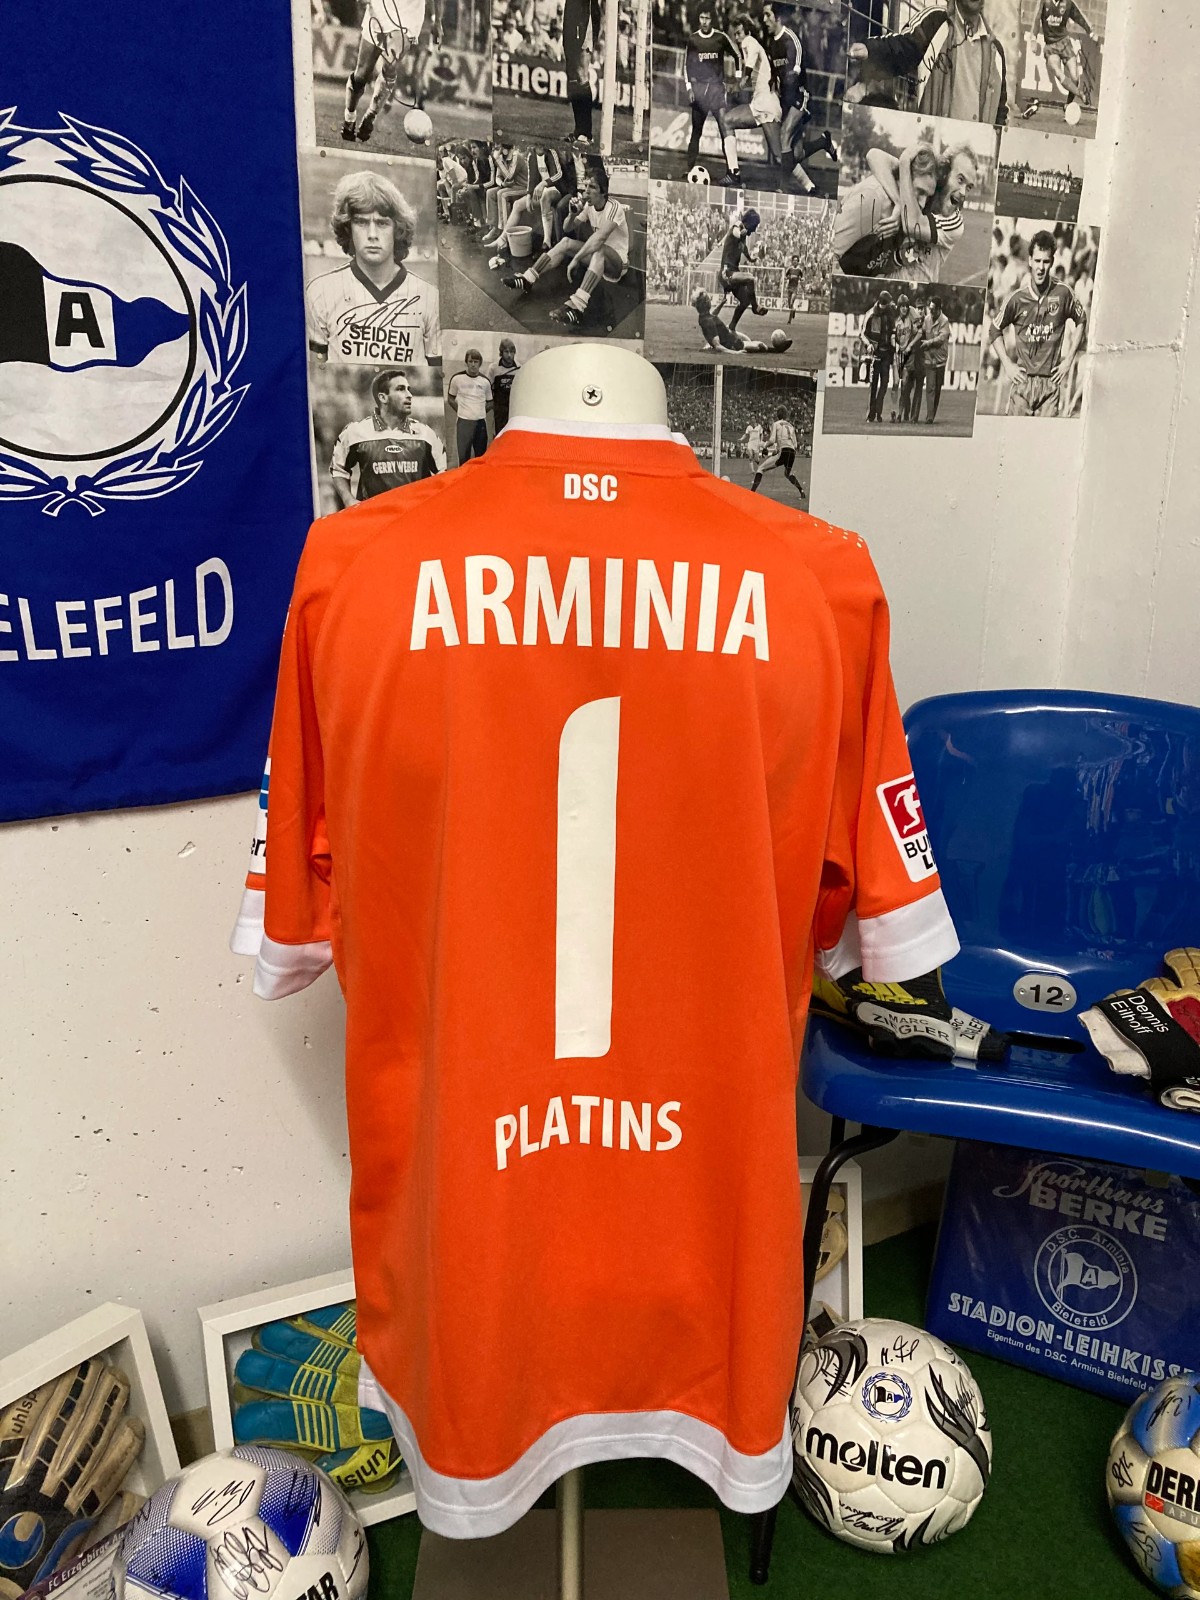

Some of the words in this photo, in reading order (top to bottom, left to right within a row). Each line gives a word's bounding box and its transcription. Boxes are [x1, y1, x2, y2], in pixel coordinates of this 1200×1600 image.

[55, 291, 105, 349] A
[350, 324, 410, 347] SEIDEN
[341, 340, 414, 363] STICKER
[372, 460, 396, 475] GERRY
[396, 460, 418, 474] WEBER
[563, 473, 618, 501] DSC
[409, 554, 770, 662] ARMINIA
[904, 834, 932, 859] BU
[554, 696, 621, 1060] 1
[1029, 984, 1064, 1006] 12
[1128, 995, 1169, 1034] Dennis
[872, 1013, 950, 1042] ZIEGLER
[888, 1013, 929, 1025] MARC
[1110, 1000, 1154, 1035] Eilhoff
[494, 1094, 683, 1171] PLATINS
[1029, 1183, 1168, 1242] BERKE
[1046, 1228, 1080, 1253] D.S.C.
[1092, 1231, 1130, 1274] Arminia
[1081, 1268, 1097, 1285] A
[1052, 1300, 1108, 1327] Bielefeld
[948, 1292, 1194, 1381] STADION-LEIHKISS
[987, 1329, 1024, 1348] Eigentum
[1025, 1343, 1041, 1355] des
[1070, 1358, 1105, 1377] Arminia
[1107, 1370, 1147, 1391] Bielefeld
[805, 1427, 947, 1489] molten
[1146, 1460, 1200, 1513] DER
[48, 1576, 60, 1592] FC
[61, 1540, 111, 1582] Erzgebirge
